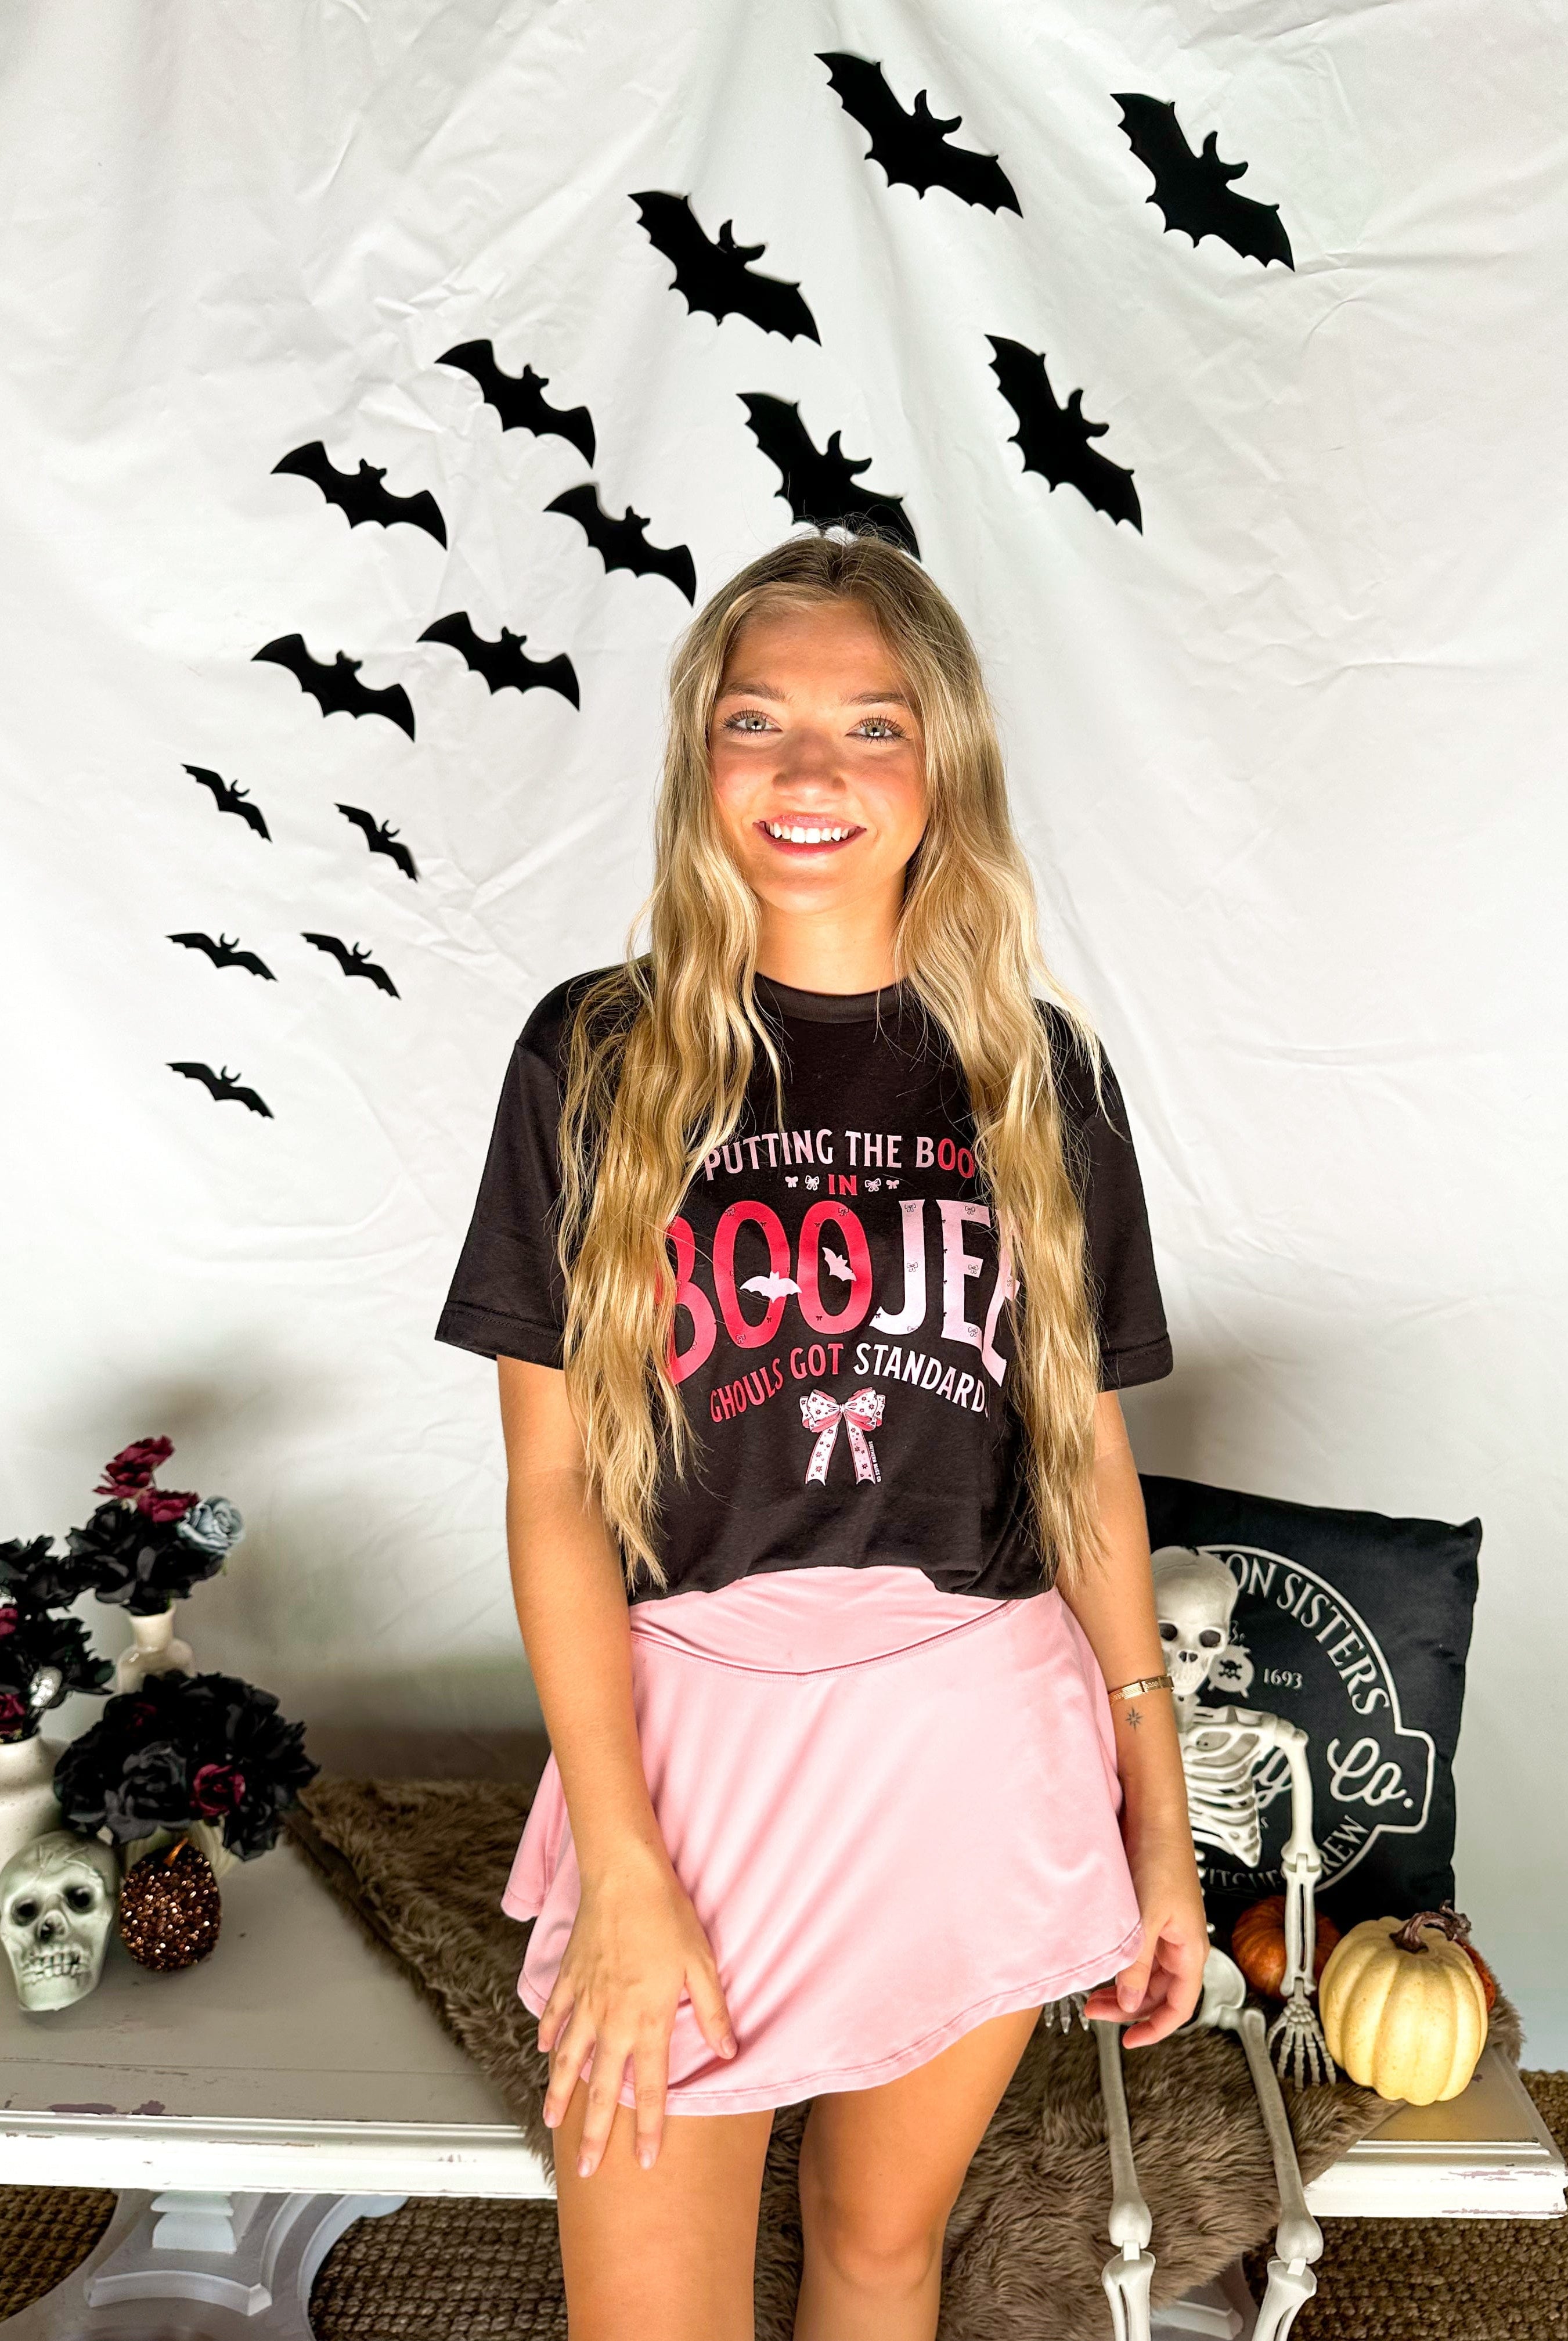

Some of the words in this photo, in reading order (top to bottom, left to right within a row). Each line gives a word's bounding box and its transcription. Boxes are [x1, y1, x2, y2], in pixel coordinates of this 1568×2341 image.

[705, 1129, 833, 1181] PUTTING
[845, 1130, 902, 1168] THE
[915, 1136, 975, 1179] BOO
[828, 1173, 857, 1195] IN
[710, 1357, 784, 1422] GHOULS
[790, 1342, 844, 1380] GOT
[853, 1342, 988, 1418] STANDARD
[868, 1440, 877, 1463] SOUTHERN
[1276, 1572, 1390, 1715] SISTERS
[1263, 1668, 1303, 1690] 1693
[1327, 1737, 1414, 1809] Co.
[1317, 1814, 1369, 1875] REW
